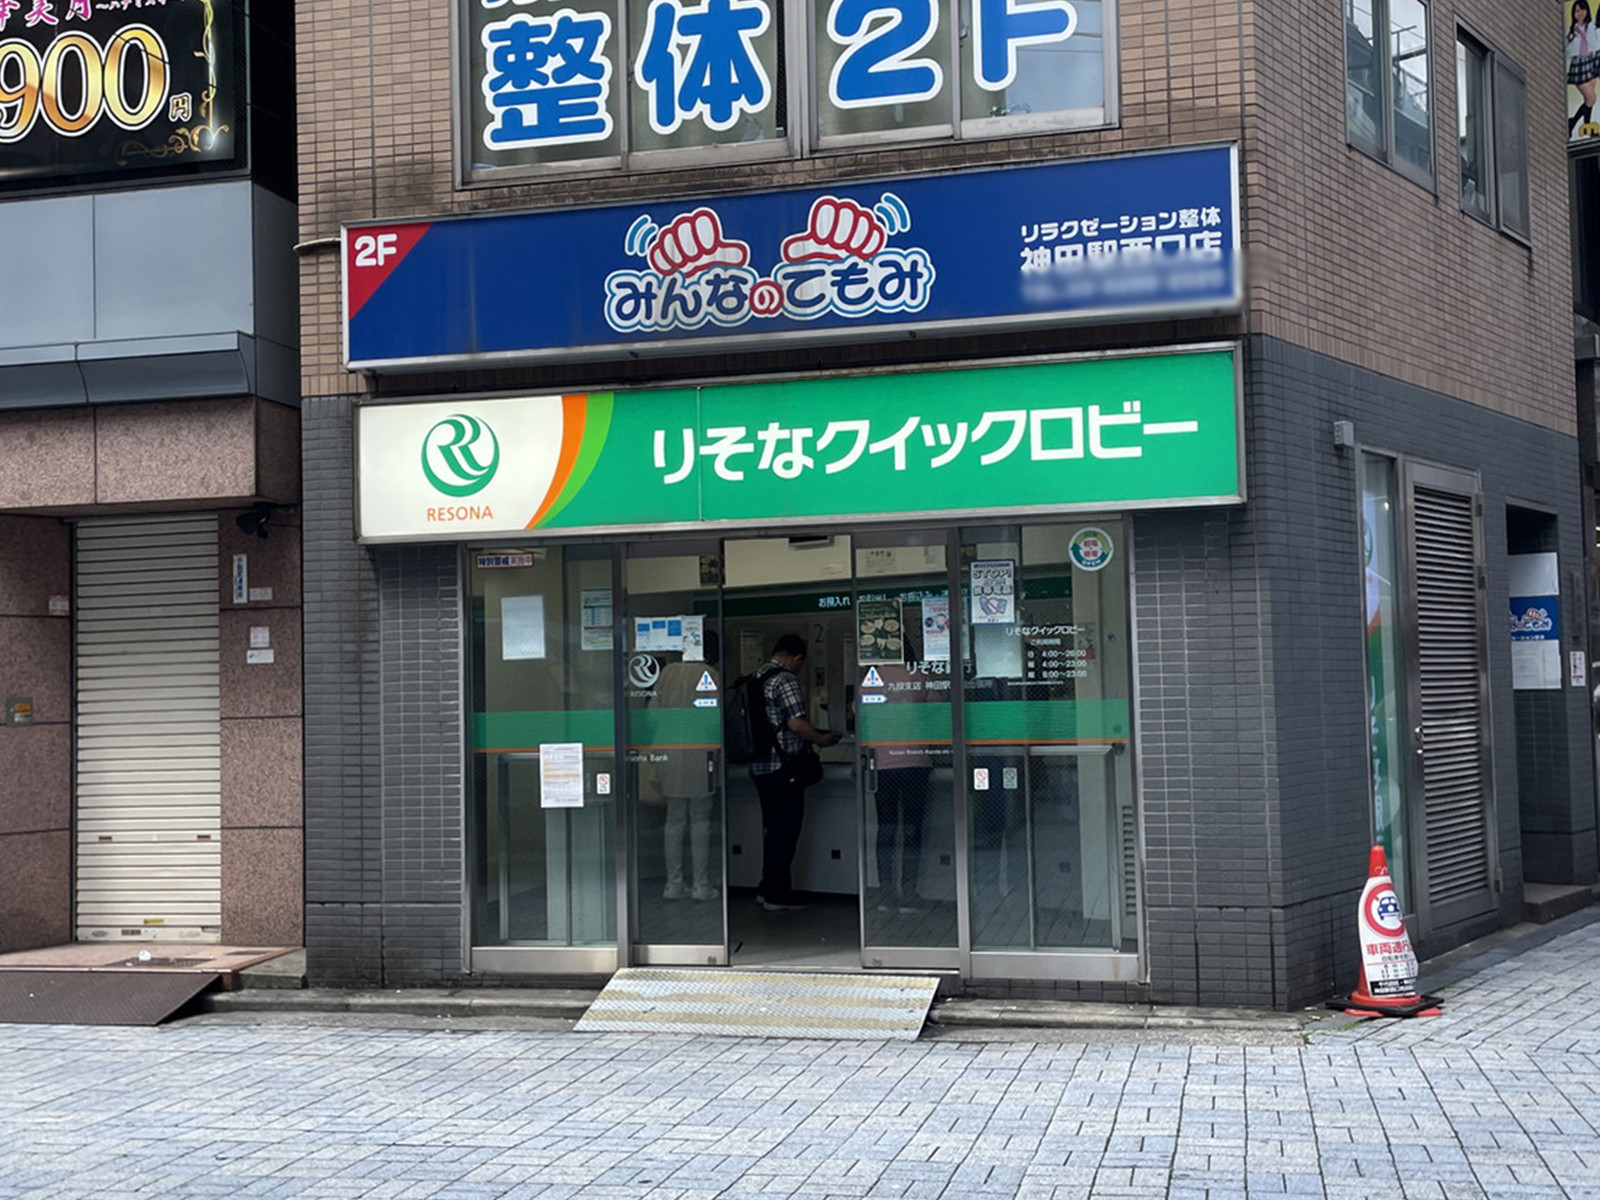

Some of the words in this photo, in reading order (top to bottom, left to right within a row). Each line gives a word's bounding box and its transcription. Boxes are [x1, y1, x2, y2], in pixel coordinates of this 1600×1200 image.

[482, 0, 773, 150] 整体
[1020, 206, 1222, 243] リラクゼーション整体
[354, 235, 398, 267] 2F
[608, 252, 932, 330] みんなのてもみ
[652, 400, 1200, 485] りそなクイックロビー
[426, 505, 494, 523] RESONA
[1005, 625, 1086, 636] りそなクイックロビー
